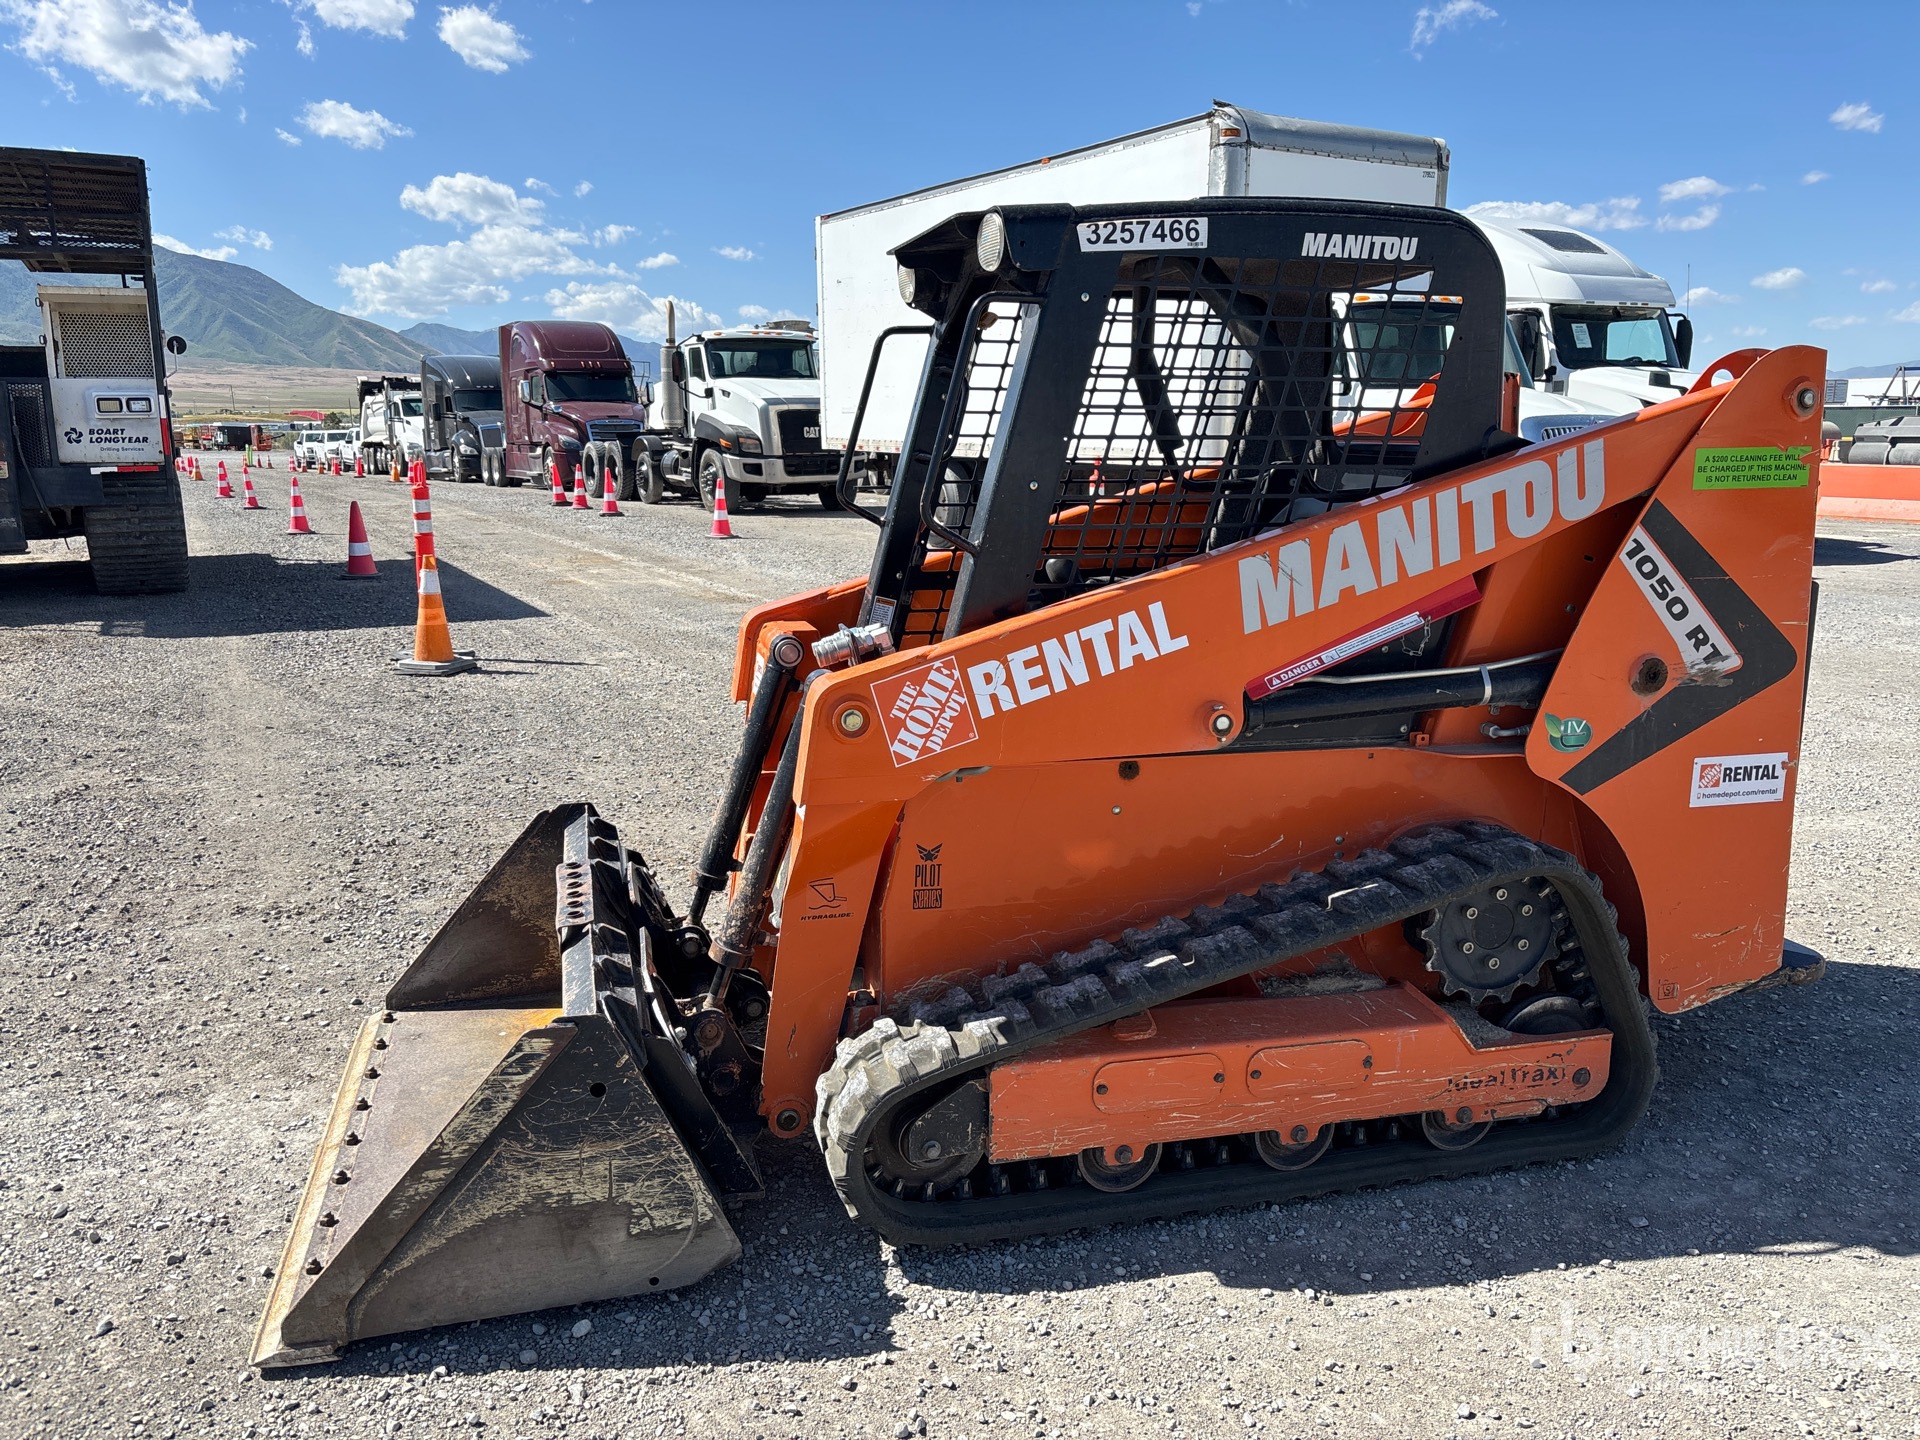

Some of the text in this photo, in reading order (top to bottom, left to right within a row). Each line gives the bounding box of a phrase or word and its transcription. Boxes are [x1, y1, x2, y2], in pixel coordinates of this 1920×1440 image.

[1086, 219, 1200, 245] 3257466
[1301, 232, 1419, 261] MANITOU
[89, 436, 149, 444] LONGYEAR
[803, 427, 820, 438] CAT
[1710, 465, 1747, 473] CHARGED
[1757, 464, 1773, 472] THIS
[1774, 463, 1807, 471] MACHINE
[1712, 455, 1729, 463] $200
[1730, 454, 1768, 463] CLEANING
[1769, 454, 1783, 462] FEE
[1705, 475, 1713, 483] IS
[1714, 475, 1730, 483] NOT
[1732, 474, 1772, 482] RETURNED
[1238, 438, 1606, 635] MANITOU
[1626, 538, 1730, 668] 1050 RT
[966, 600, 1190, 720] RENTAL
[1280, 658, 1322, 682] DANGER
[889, 681, 920, 719] THE
[891, 660, 960, 761] HOME
[925, 689, 967, 752] DEPOT
[1722, 763, 1780, 783] RENTAL
[1701, 787, 1779, 799] homedepot.com/rental
[914, 863, 943, 888] PILOT
